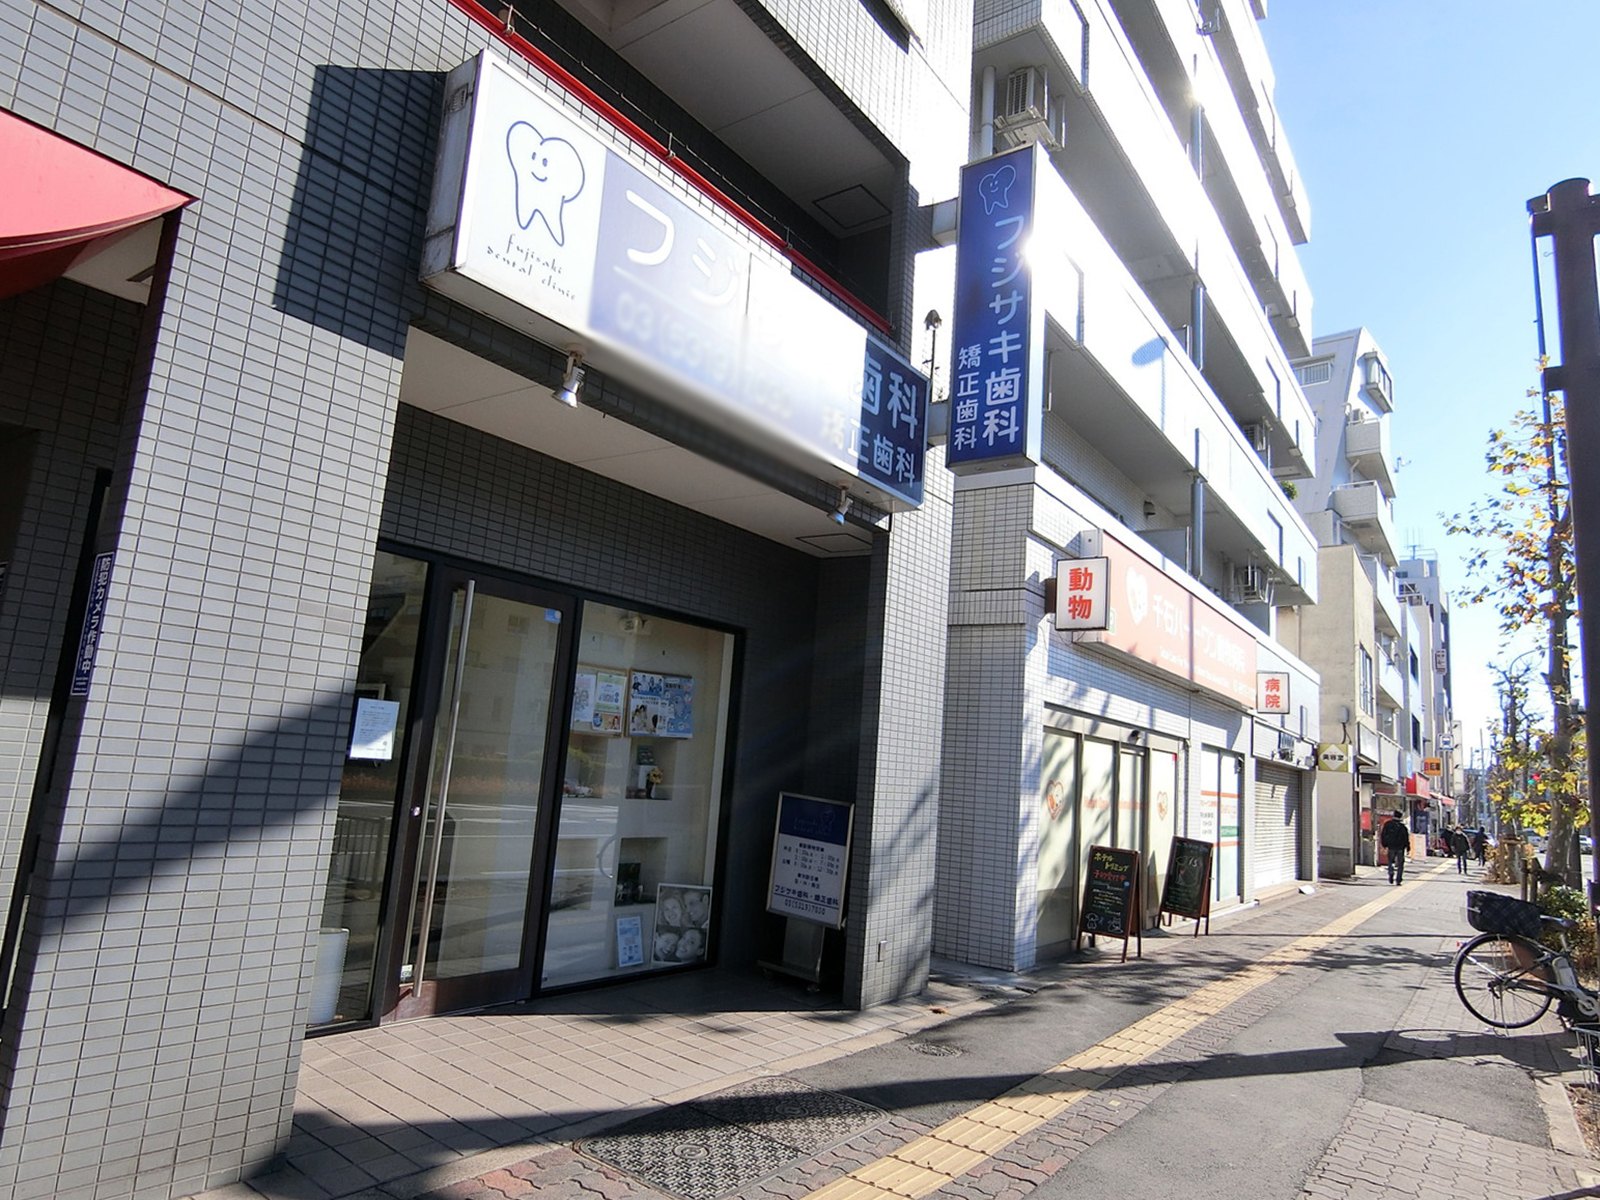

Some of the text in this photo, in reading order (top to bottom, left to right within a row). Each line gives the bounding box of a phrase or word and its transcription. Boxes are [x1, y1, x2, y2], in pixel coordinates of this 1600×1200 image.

[487, 246, 576, 300] dental clinic
[506, 233, 562, 274] fujisaki
[983, 214, 1024, 446] フジサキ歯科
[954, 346, 982, 451] 矯正歯科
[819, 404, 916, 488] 矯正歯科
[81, 557, 112, 674] 防犯カメラ作動中
[1068, 567, 1094, 620] 動物
[1265, 678, 1281, 708] 病院
